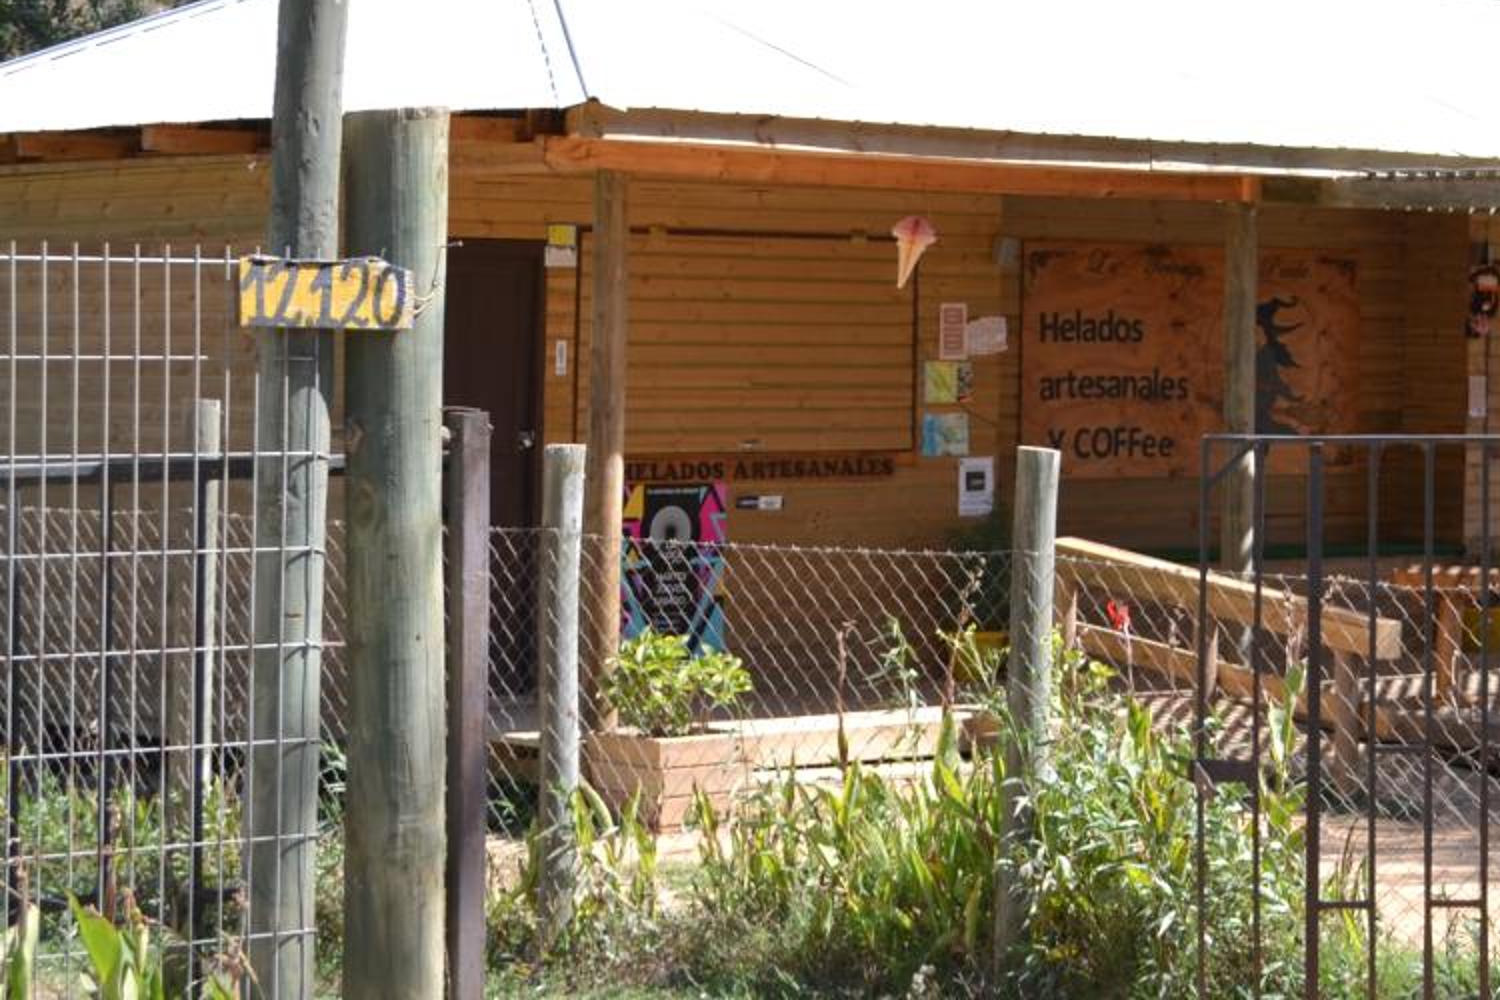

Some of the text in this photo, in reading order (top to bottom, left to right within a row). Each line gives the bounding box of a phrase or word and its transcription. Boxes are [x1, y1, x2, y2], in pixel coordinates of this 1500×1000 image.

[1039, 311, 1143, 344] Helados
[1039, 368, 1188, 402] artesanales
[736, 457, 894, 480] ARTESANALES
